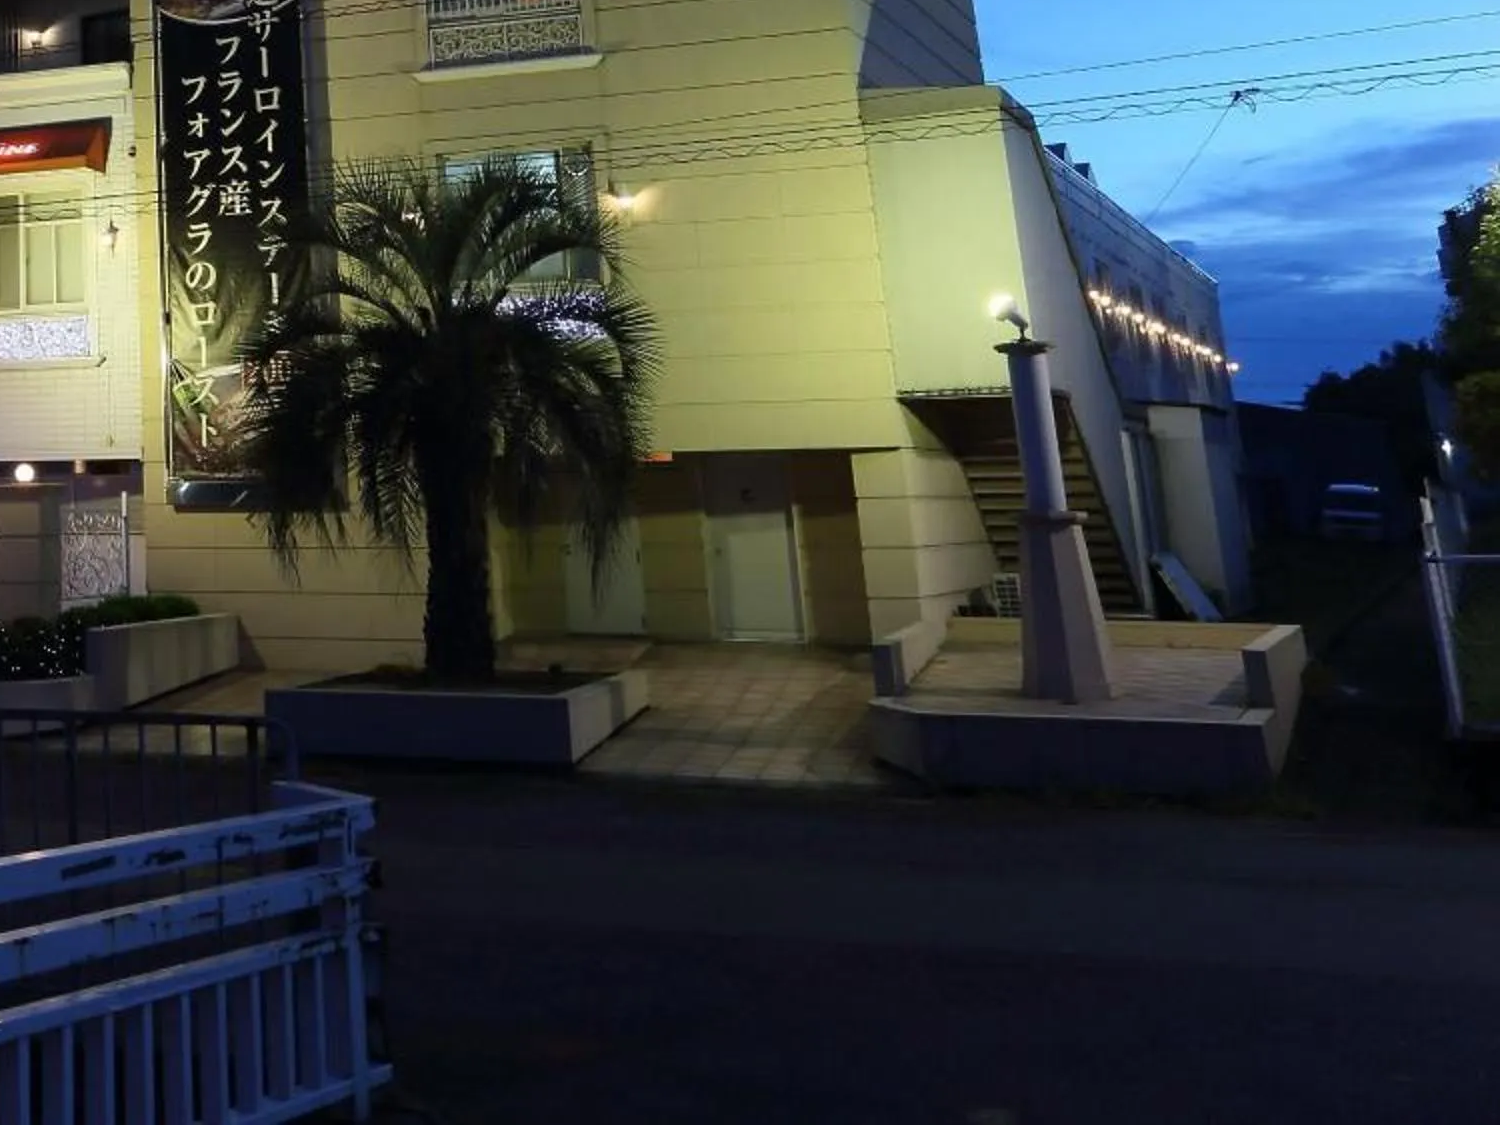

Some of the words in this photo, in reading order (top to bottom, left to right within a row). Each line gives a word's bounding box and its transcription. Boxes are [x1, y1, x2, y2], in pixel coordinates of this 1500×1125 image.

[181, 76, 219, 447] フォアグラのロースト
[215, 35, 252, 216] フランス産
